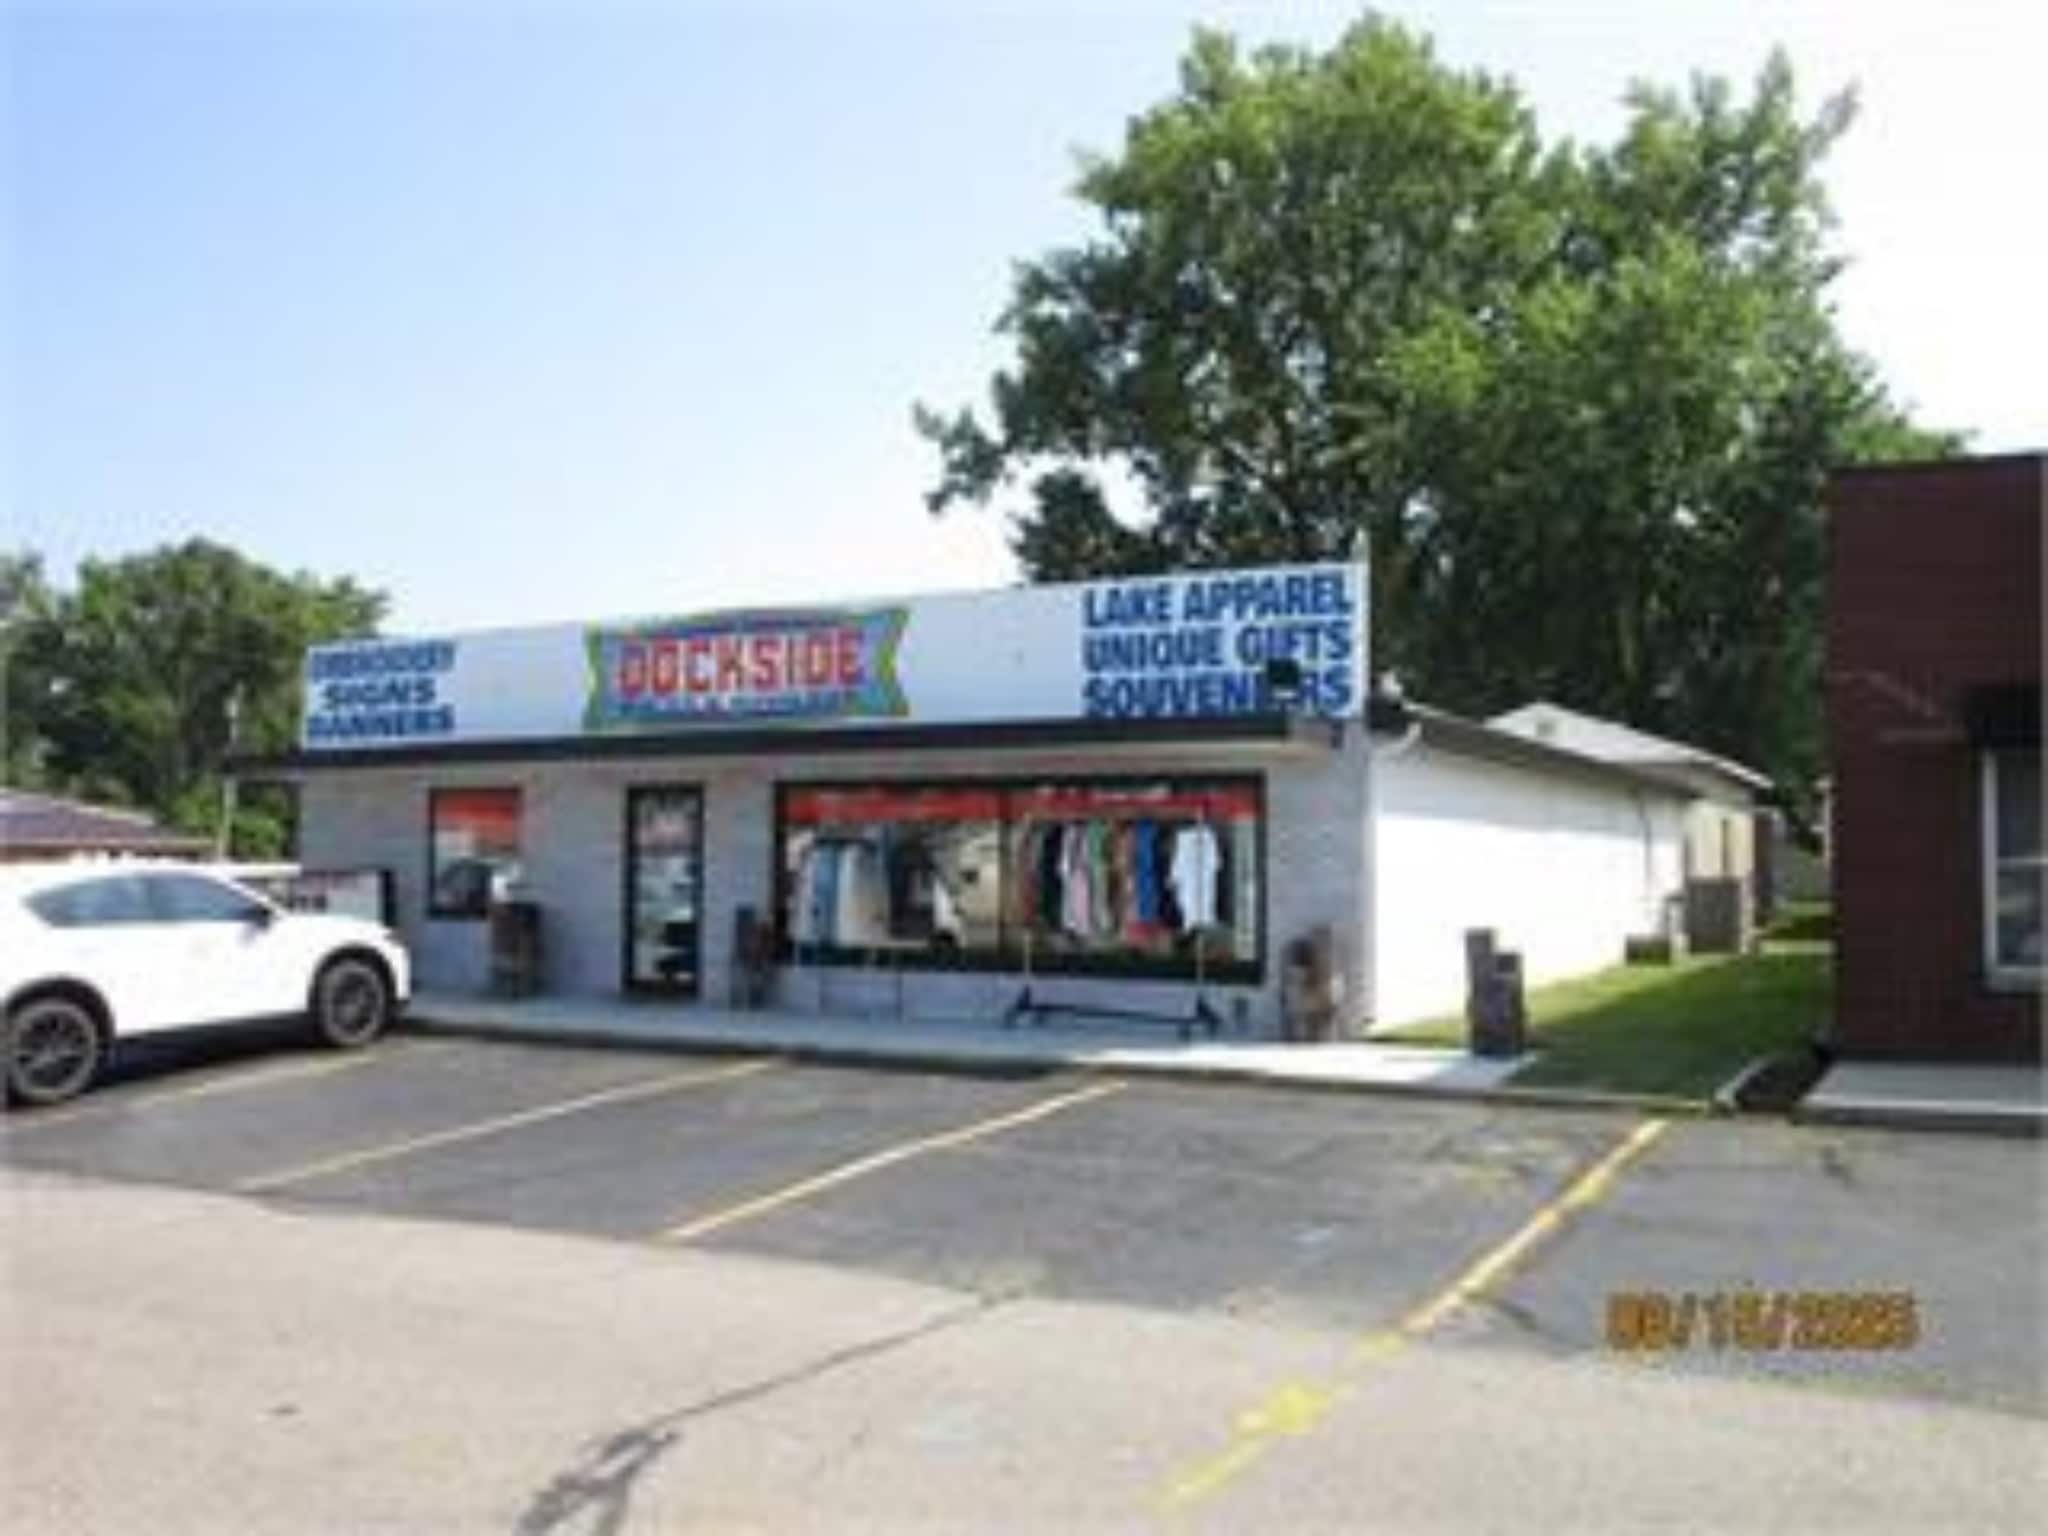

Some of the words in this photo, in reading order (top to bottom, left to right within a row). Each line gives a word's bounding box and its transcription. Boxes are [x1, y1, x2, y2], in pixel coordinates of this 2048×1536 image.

[1084, 584, 1172, 627] LAKE
[1182, 571, 1352, 620] APPAREL
[619, 626, 866, 698] DOCKSIDE
[1083, 627, 1224, 671] UNIQUE
[1235, 619, 1352, 664] GIFTS
